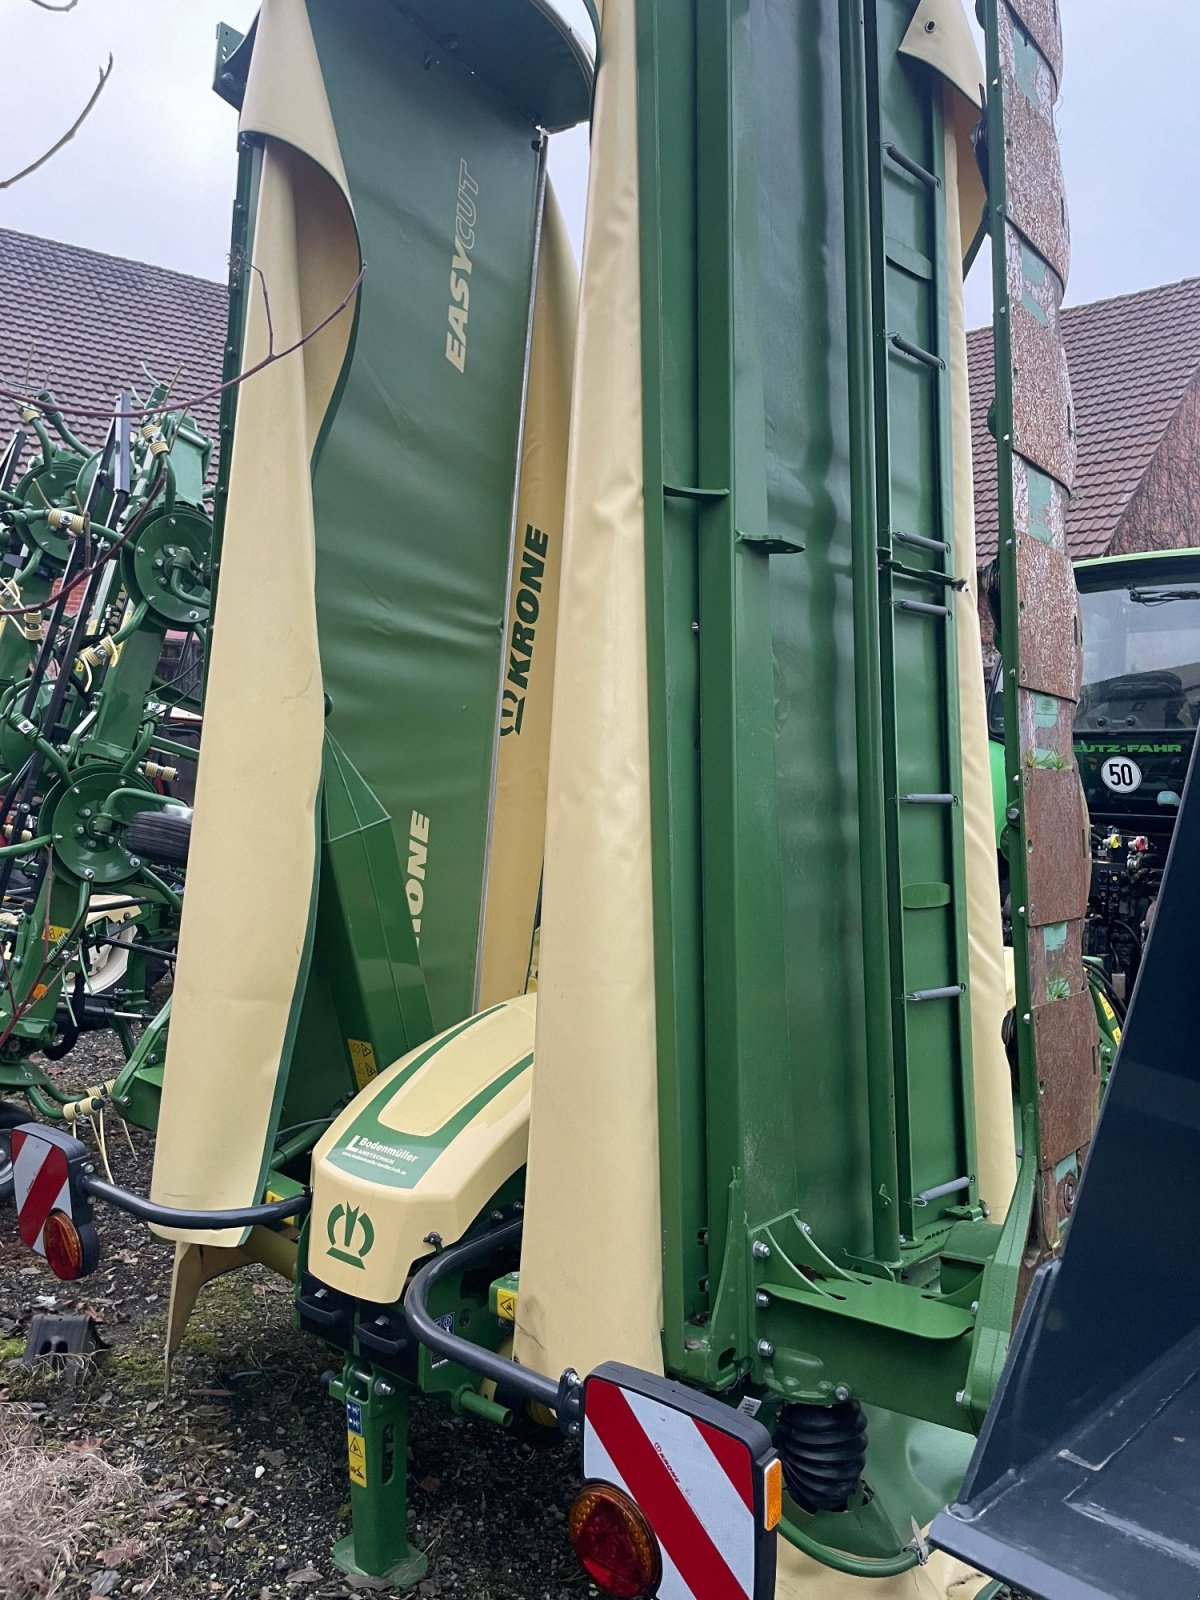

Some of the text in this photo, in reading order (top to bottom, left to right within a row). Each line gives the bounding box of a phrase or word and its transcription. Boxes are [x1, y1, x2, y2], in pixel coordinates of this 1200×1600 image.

[445, 158, 479, 374] EASYCUT
[508, 523, 549, 690] KRONE
[1072, 744, 1182, 753] EUTZ-FAHR
[1108, 763, 1134, 787] 50
[405, 809, 431, 948] ONE
[358, 1136, 419, 1163] Bodenmüller
[659, 1452, 681, 1484] KRONE
